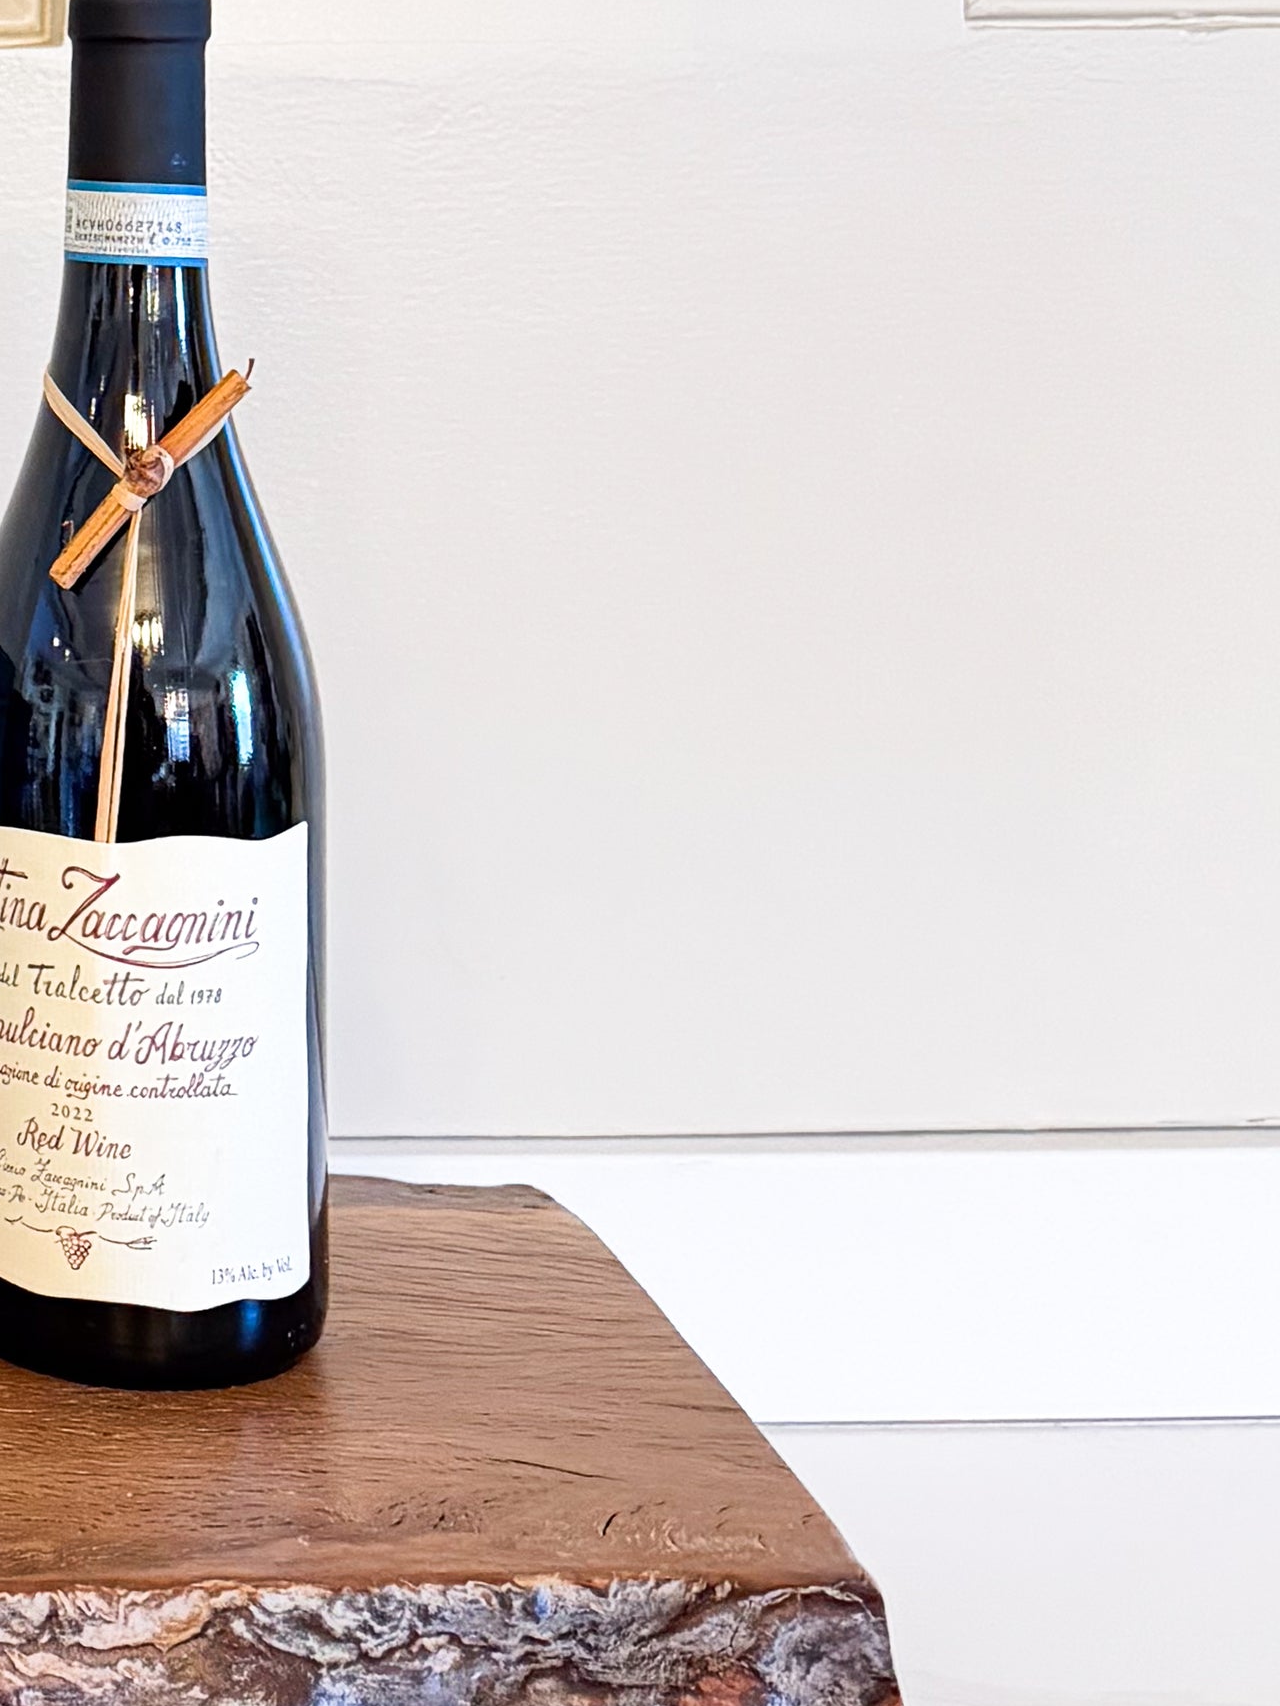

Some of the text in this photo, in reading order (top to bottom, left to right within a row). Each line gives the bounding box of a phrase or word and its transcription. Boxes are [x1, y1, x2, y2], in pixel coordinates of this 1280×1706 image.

[47, 866, 259, 967] Zaccagnini
[28, 964, 150, 1006] Tralcetto
[155, 980, 185, 1005] dal
[190, 988, 222, 1005] 1978
[107, 1020, 259, 1073] d'Abruzzo
[44, 1065, 63, 1089] di
[64, 1073, 124, 1101] origine
[129, 1072, 239, 1099] controllata
[51, 1103, 94, 1122] 2022
[16, 1117, 132, 1160] Red Wine
[30, 1158, 107, 1192] Zaccagnini
[34, 1188, 89, 1217] Italia
[96, 1201, 146, 1222] Product
[148, 1205, 162, 1229] of
[160, 1201, 211, 1229] Italy
[212, 1267, 236, 1286] 13%
